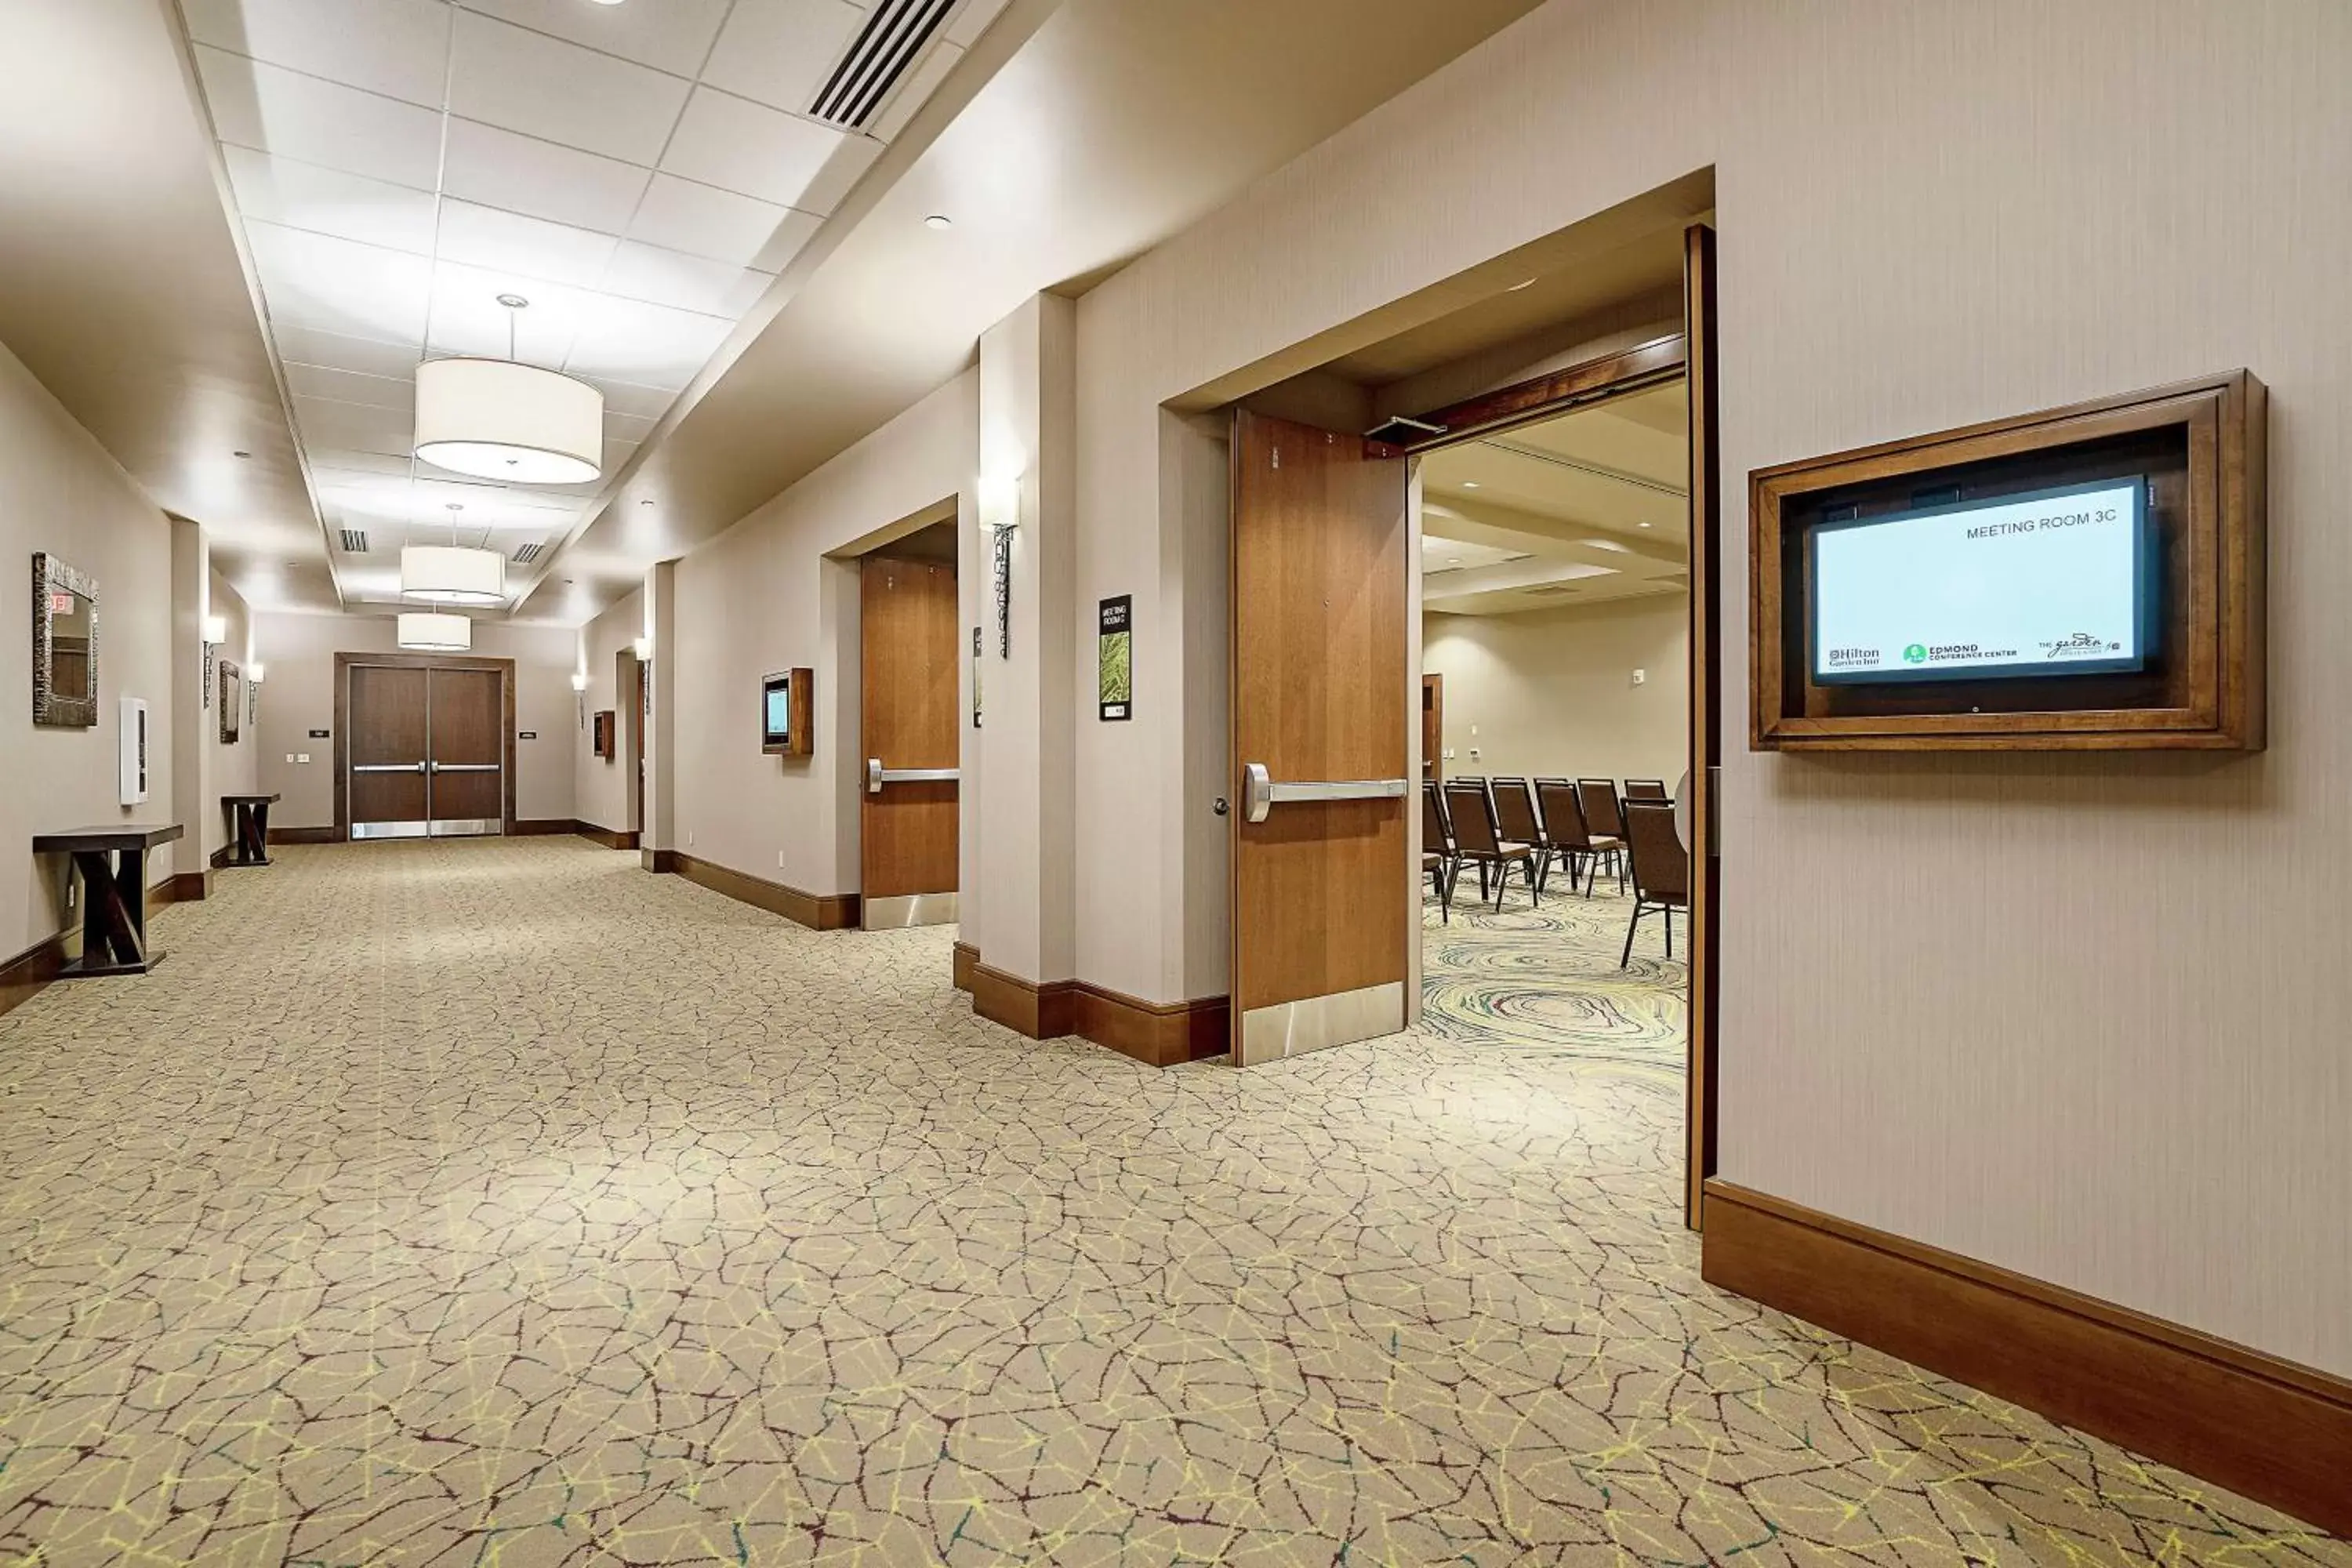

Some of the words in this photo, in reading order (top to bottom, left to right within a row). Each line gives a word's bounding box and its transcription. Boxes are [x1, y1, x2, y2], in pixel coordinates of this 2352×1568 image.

[1967, 520, 2034, 539] MEETING
[2039, 513, 2089, 529] ROOM
[2096, 509, 2116, 523] 3C
[1840, 648, 1879, 659] Hilton
[1929, 644, 1978, 655] EDMOND
[1929, 652, 1982, 660] CONFERENCE
